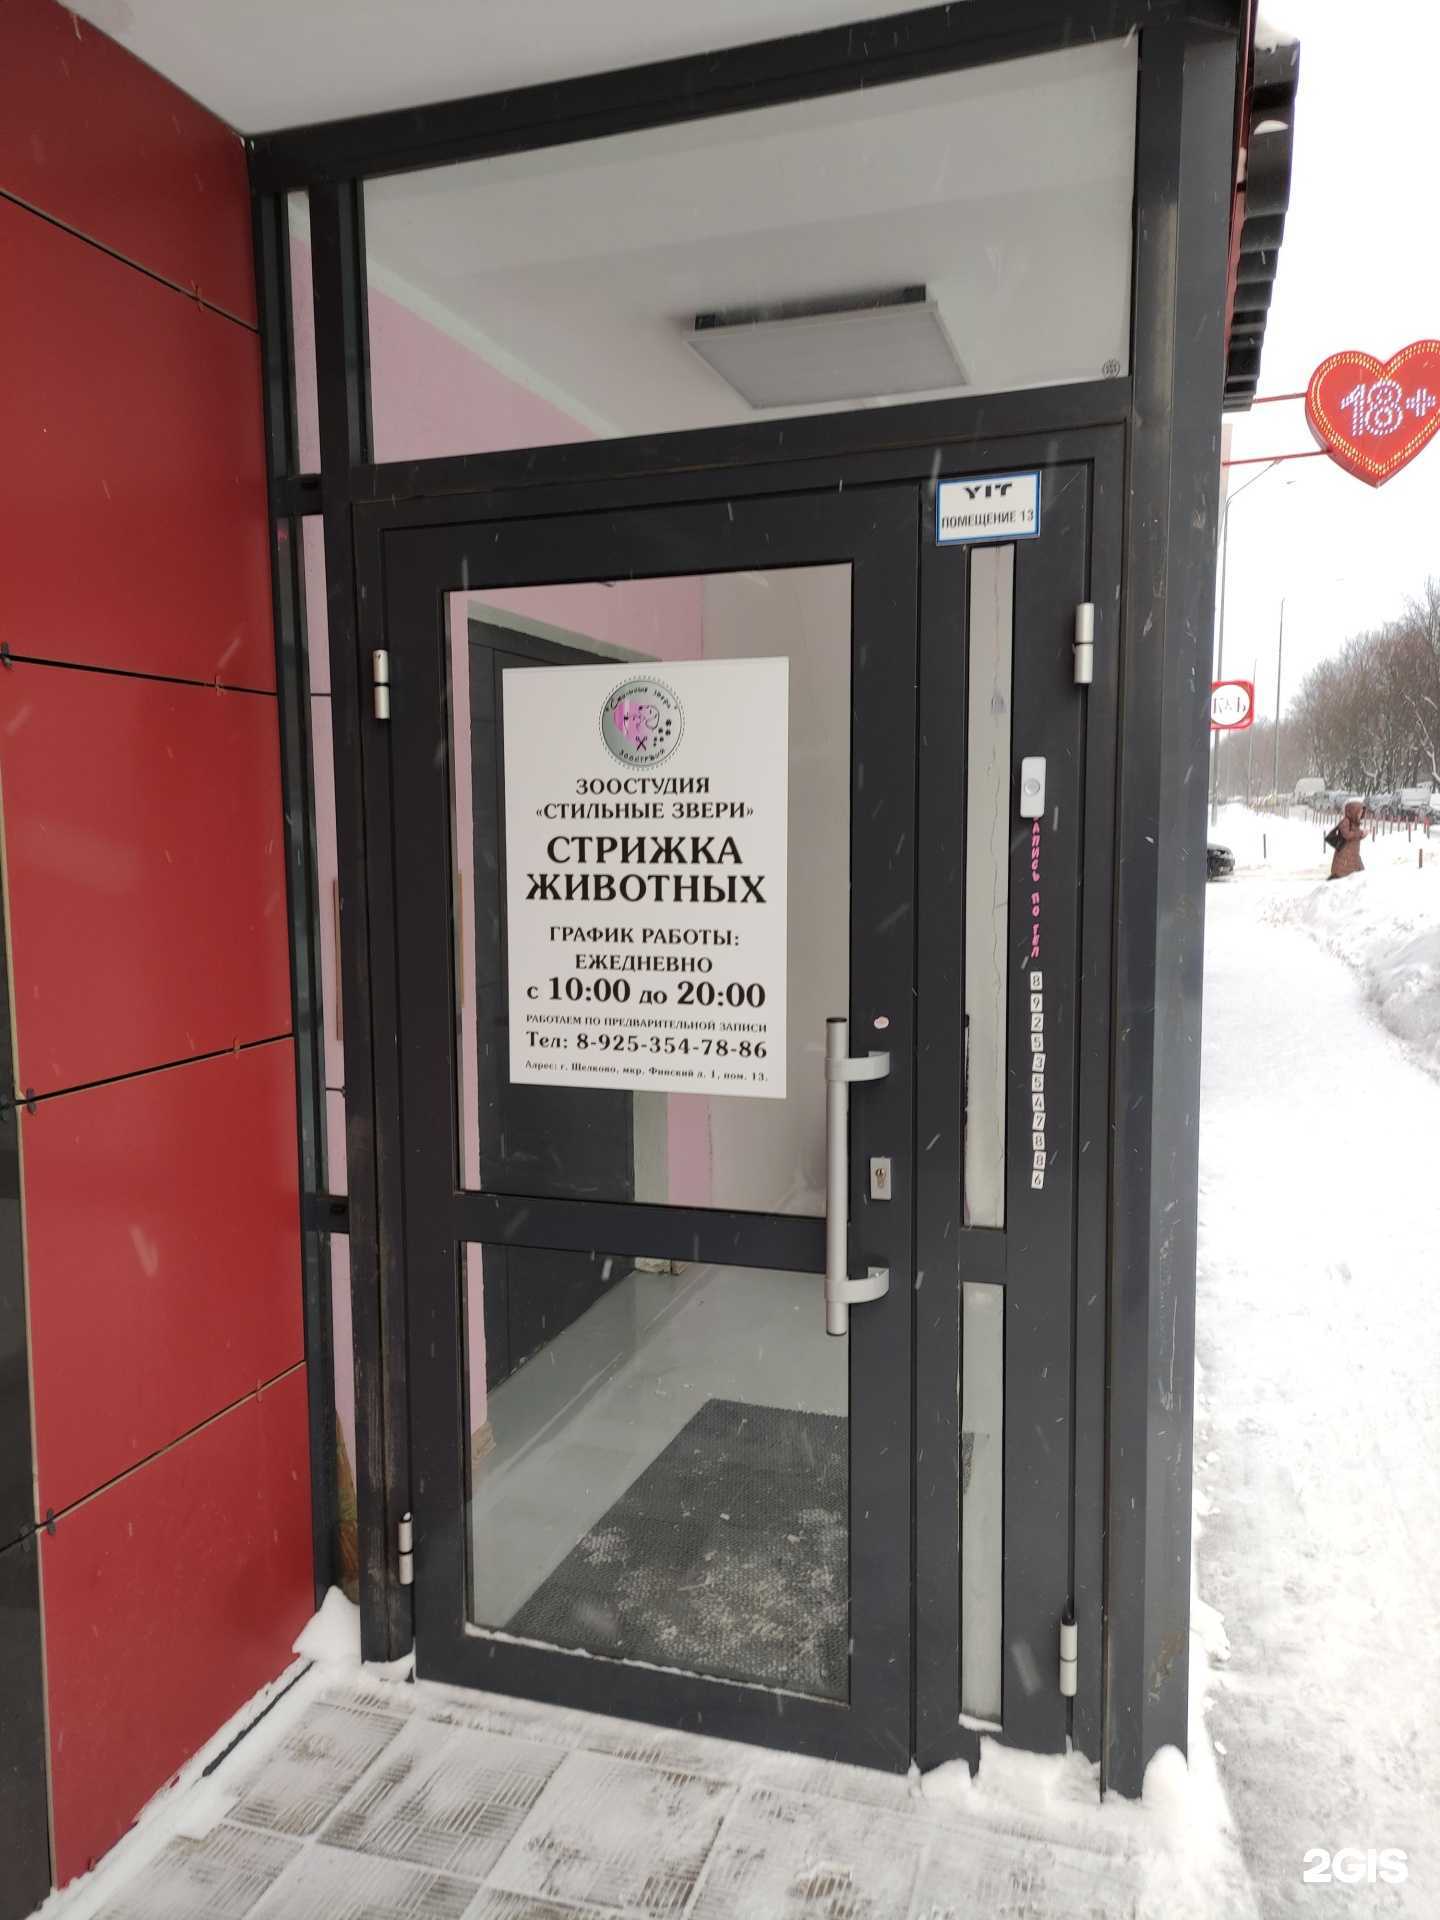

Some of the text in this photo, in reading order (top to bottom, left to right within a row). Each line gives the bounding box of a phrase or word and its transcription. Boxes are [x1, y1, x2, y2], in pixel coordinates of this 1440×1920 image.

[1339, 378, 1436, 436] 18+
[965, 483, 1012, 499] YIT
[941, 508, 1034, 530] ПОМЕЩЕНИЕ 13
[575, 776, 711, 796] ЗООСТУДИЯ
[536, 801, 754, 820] «СТИЛЬНЫЕ ЗВЕРИ»
[546, 835, 744, 865] СТРИЖКА
[525, 873, 768, 904] ЖИВОТНЫХ
[549, 926, 740, 947] ГРАФИК РАБОТЫ:
[575, 954, 713, 974] ЕЖЕДНЕВНО
[548, 976, 631, 1003] 10:00
[638, 988, 668, 1006] до
[676, 980, 767, 1008] 20:00
[526, 1013, 767, 1033] РАБОТАЕМ ПО ПРЕДВАРИТЕЛЬНОЙ ЗАПИСИ
[526, 1030, 768, 1059] Тел: 8-925-354-78-86
